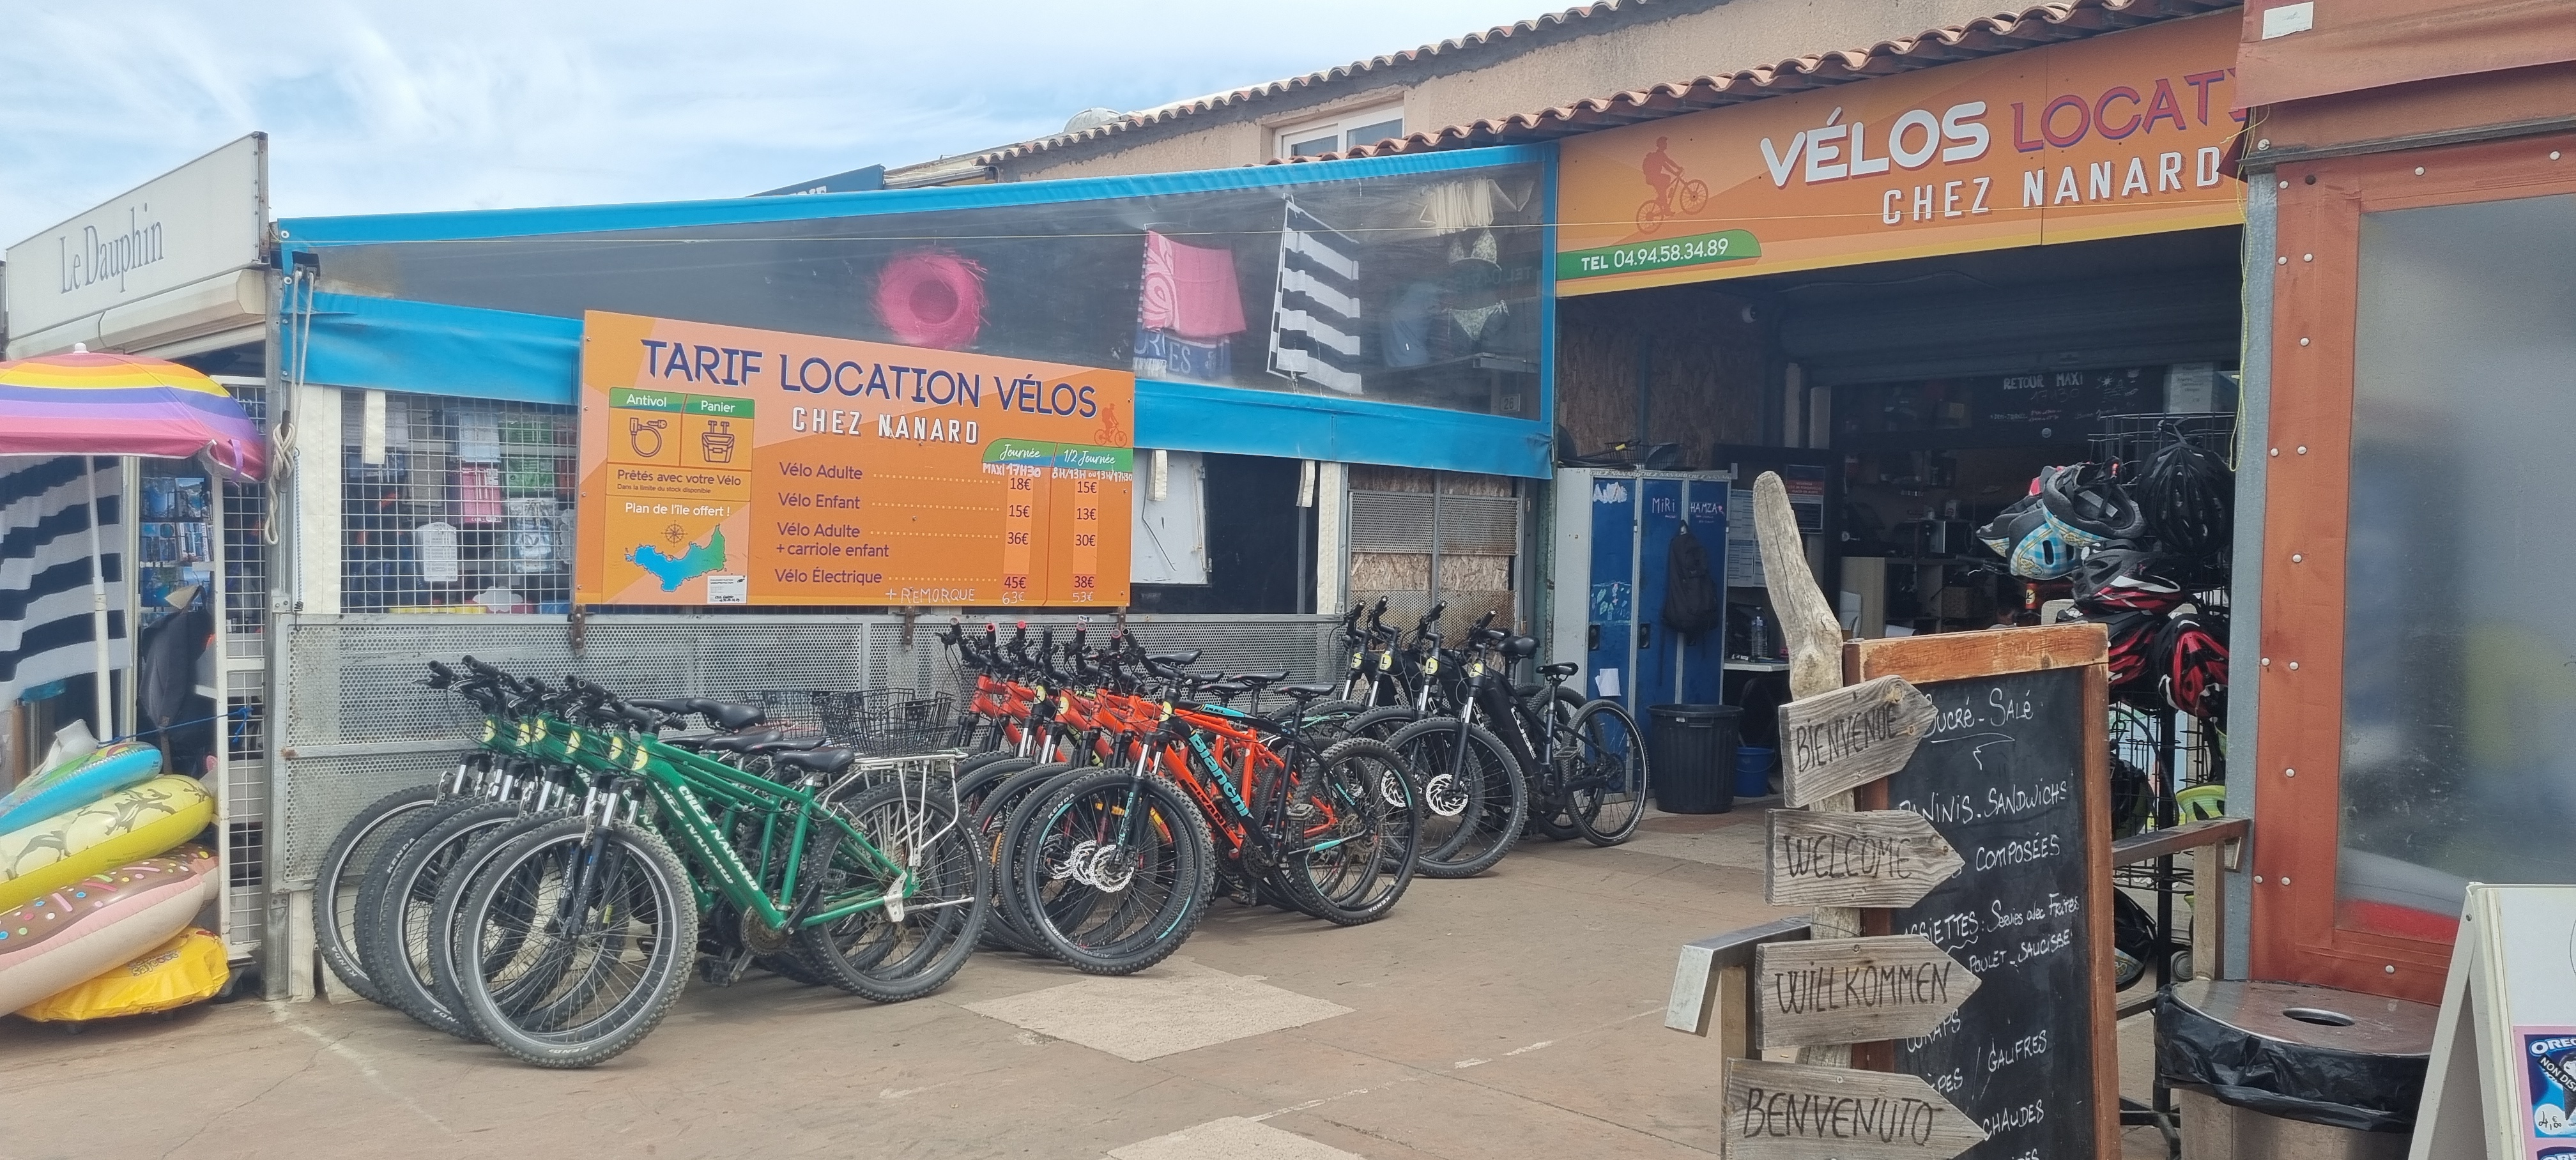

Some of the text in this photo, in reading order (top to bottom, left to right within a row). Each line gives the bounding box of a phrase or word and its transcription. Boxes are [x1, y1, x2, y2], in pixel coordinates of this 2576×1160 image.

[1760, 67, 2246, 188] VÉLOS LOCAT
[1882, 146, 2221, 225] CHEZ NANARD
[59, 202, 164, 294] Le Dauphin
[1581, 237, 1729, 271] TEL 04.94.58.34.89
[640, 339, 1098, 419] TARIF LOCATION VÉLOS
[2004, 374, 2044, 390] RETOUR
[626, 393, 667, 408] Antivol
[701, 401, 735, 413] Panier
[1503, 397, 1514, 410] 26
[792, 407, 978, 444] CHEZ NANARD
[1000, 444, 1041, 460] Journée
[1064, 449, 1116, 466] 1/2 Journée
[618, 469, 742, 485] Prêtés avec votre Vélo
[779, 462, 863, 480] Vélo Adulte
[983, 463, 1041, 477] MAXI 17H30
[1010, 478, 1032, 491] 18€
[1077, 481, 1098, 494] 15€
[778, 492, 861, 509] Vélo Enfant
[1690, 502, 1719, 514] HAMZA
[625, 502, 650, 514] Plan
[652, 503, 668, 515] de
[693, 505, 724, 517] offert
[1009, 505, 1031, 518] 15€
[1077, 508, 1097, 521] 13€
[777, 522, 861, 538] Vélo Adulte
[1007, 531, 1029, 545] 36€
[1075, 534, 1096, 547] 30€
[845, 544, 890, 558] enfant
[774, 567, 882, 586] Vélo Électrique
[1004, 576, 1027, 589] 45€
[1074, 576, 1095, 588] 38€
[900, 587, 976, 604] REMORQUE
[1002, 591, 1025, 605] 63€
[1072, 591, 1094, 603] 53€
[1796, 703, 1898, 774] BIENVENUE
[1188, 732, 1250, 817] Bianchi
[1047, 793, 1076, 820] KENDA
[678, 786, 760, 891] CHEZ NANARD
[967, 827, 983, 862] KENDA
[387, 837, 415, 874] KENDA
[1782, 833, 1912, 880] WELCOME
[1975, 832, 2061, 873] COMPOSÉES
[1367, 895, 1391, 913] KENDA
[1968, 950, 2007, 973] POULET
[2018, 929, 2071, 963] SAUCISSE
[1774, 960, 1952, 1015] WILLKOMMEN
[1988, 1029, 2048, 1072] GAUFRES
[2540, 1057, 2561, 1077] NON
[1744, 1087, 1935, 1147] BENVENUTO
[1982, 1099, 2044, 1141] CHAUDES
